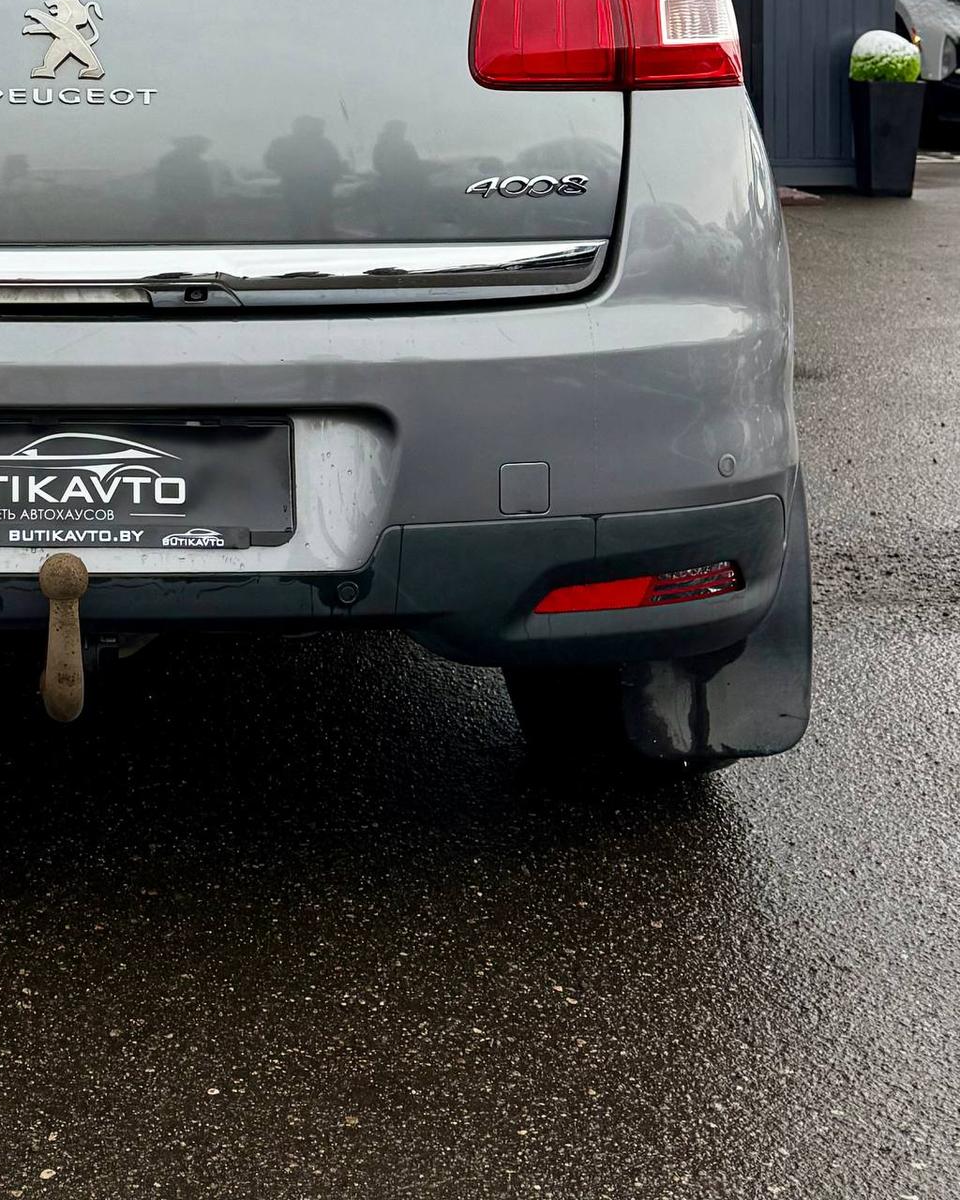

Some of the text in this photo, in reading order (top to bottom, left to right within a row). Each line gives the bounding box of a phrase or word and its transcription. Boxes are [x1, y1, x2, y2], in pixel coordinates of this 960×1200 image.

[465, 174, 590, 199] 4008
[20, 509, 115, 521] АВТОХАУСОВ
[9, 529, 144, 543] BUTIKAVTO.BY
[162, 538, 225, 547] BUTIKAVTO
